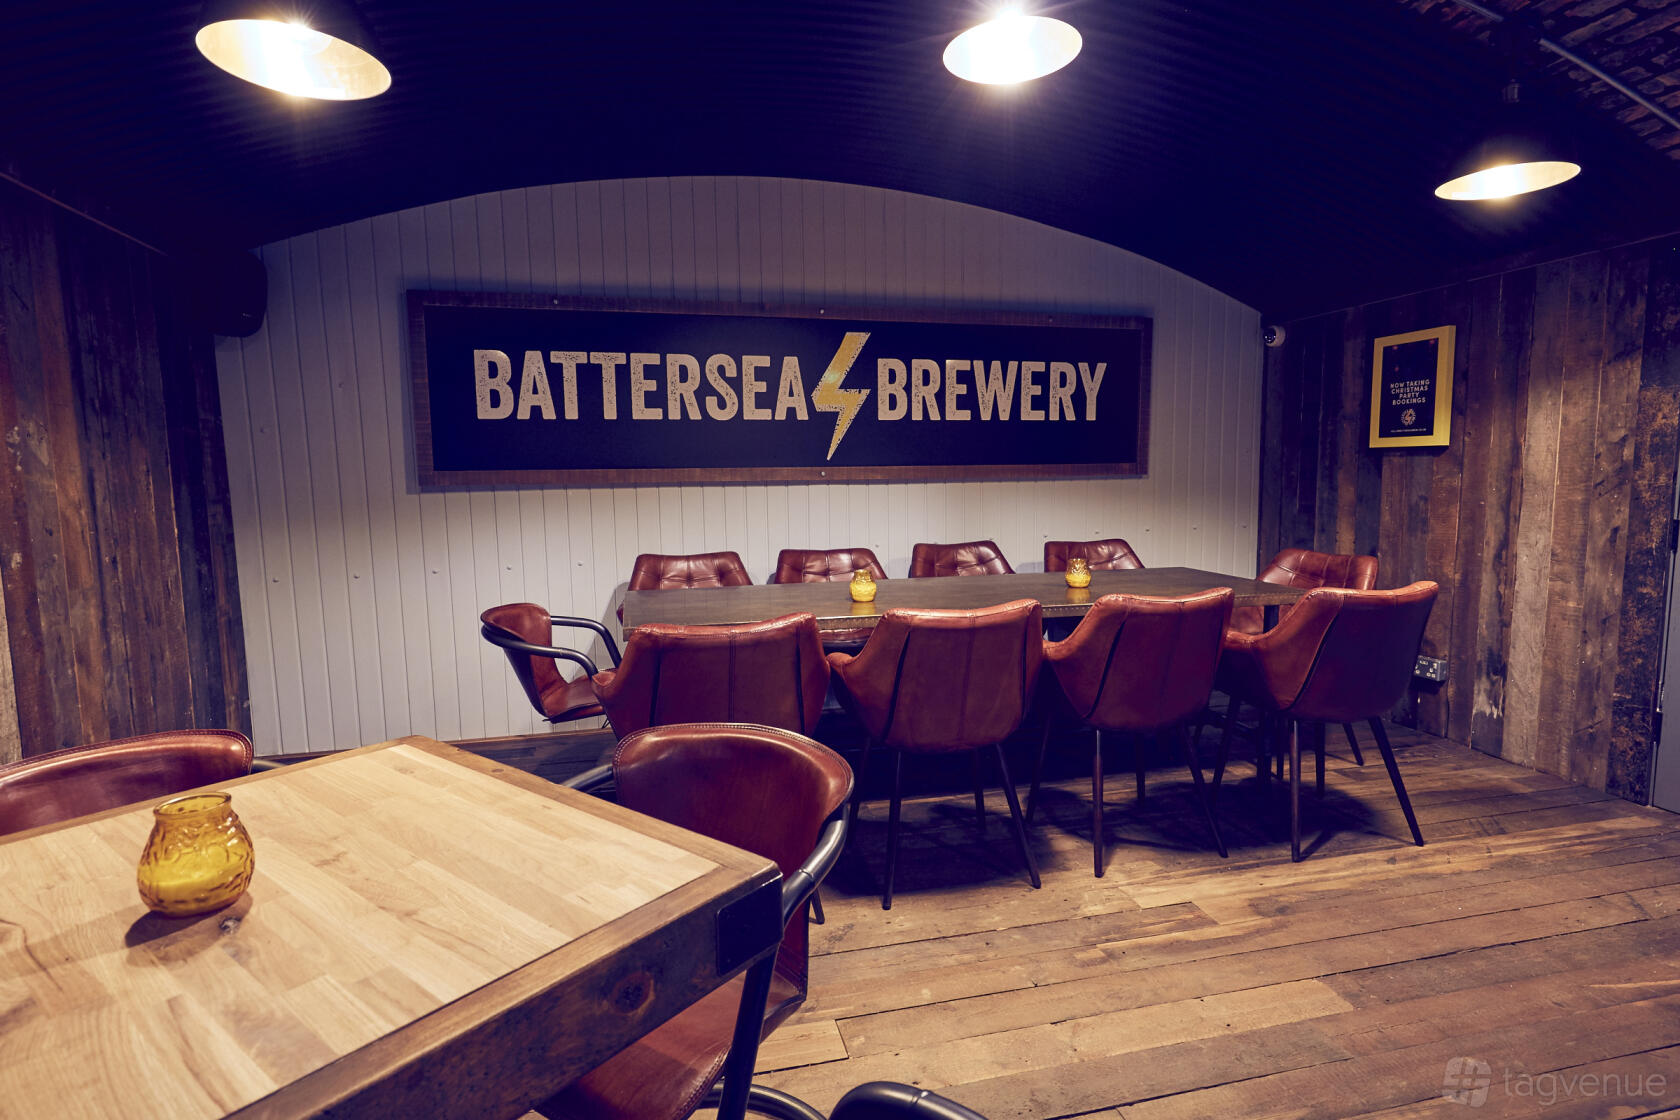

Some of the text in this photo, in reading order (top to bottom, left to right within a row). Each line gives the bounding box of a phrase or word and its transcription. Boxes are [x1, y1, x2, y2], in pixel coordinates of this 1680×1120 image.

[474, 349, 1108, 421] BATTERSEA BREWERY
[1406, 379, 1430, 387] TAKING
[1391, 385, 1428, 394] CHRISTMAS
[1399, 391, 1420, 399] PARTY
[1392, 397, 1426, 405] BOOKINGS
